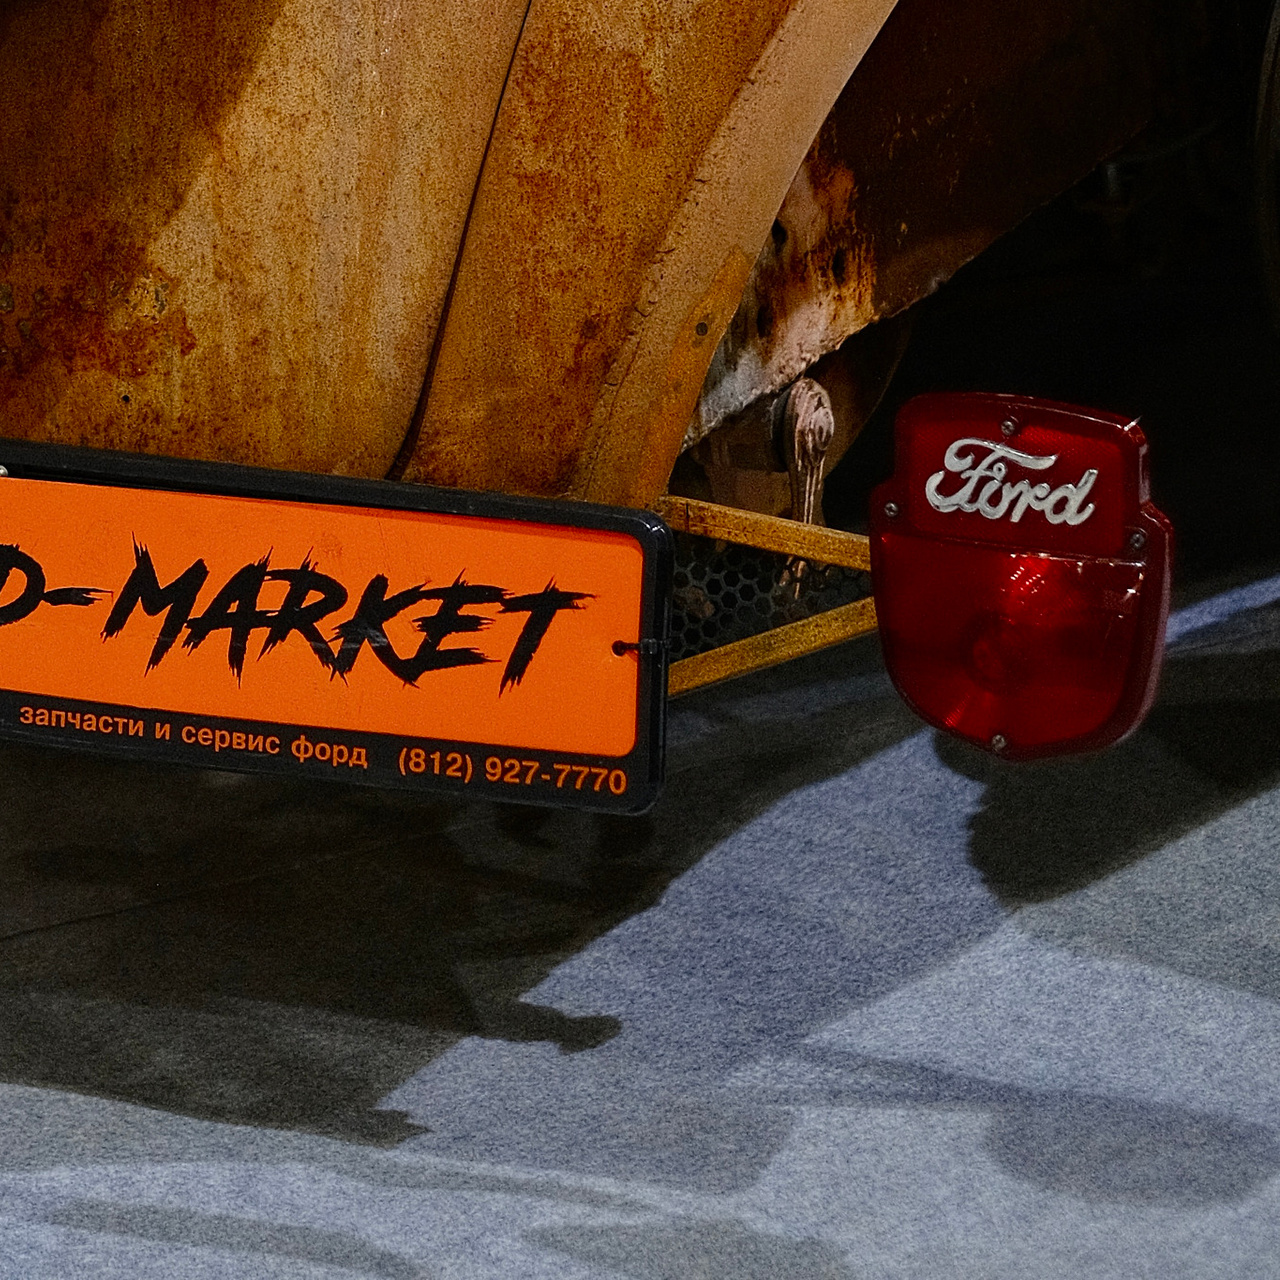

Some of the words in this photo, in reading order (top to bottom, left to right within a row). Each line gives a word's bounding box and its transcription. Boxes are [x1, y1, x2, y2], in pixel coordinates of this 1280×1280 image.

[926, 438, 1099, 526] Ford
[19, 706, 144, 737] запчасти
[155, 721, 170, 740] и
[182, 725, 280, 753] сервис
[291, 735, 368, 769] форд
[398, 747, 473, 784] (812)
[485, 756, 627, 796] 927-7770
